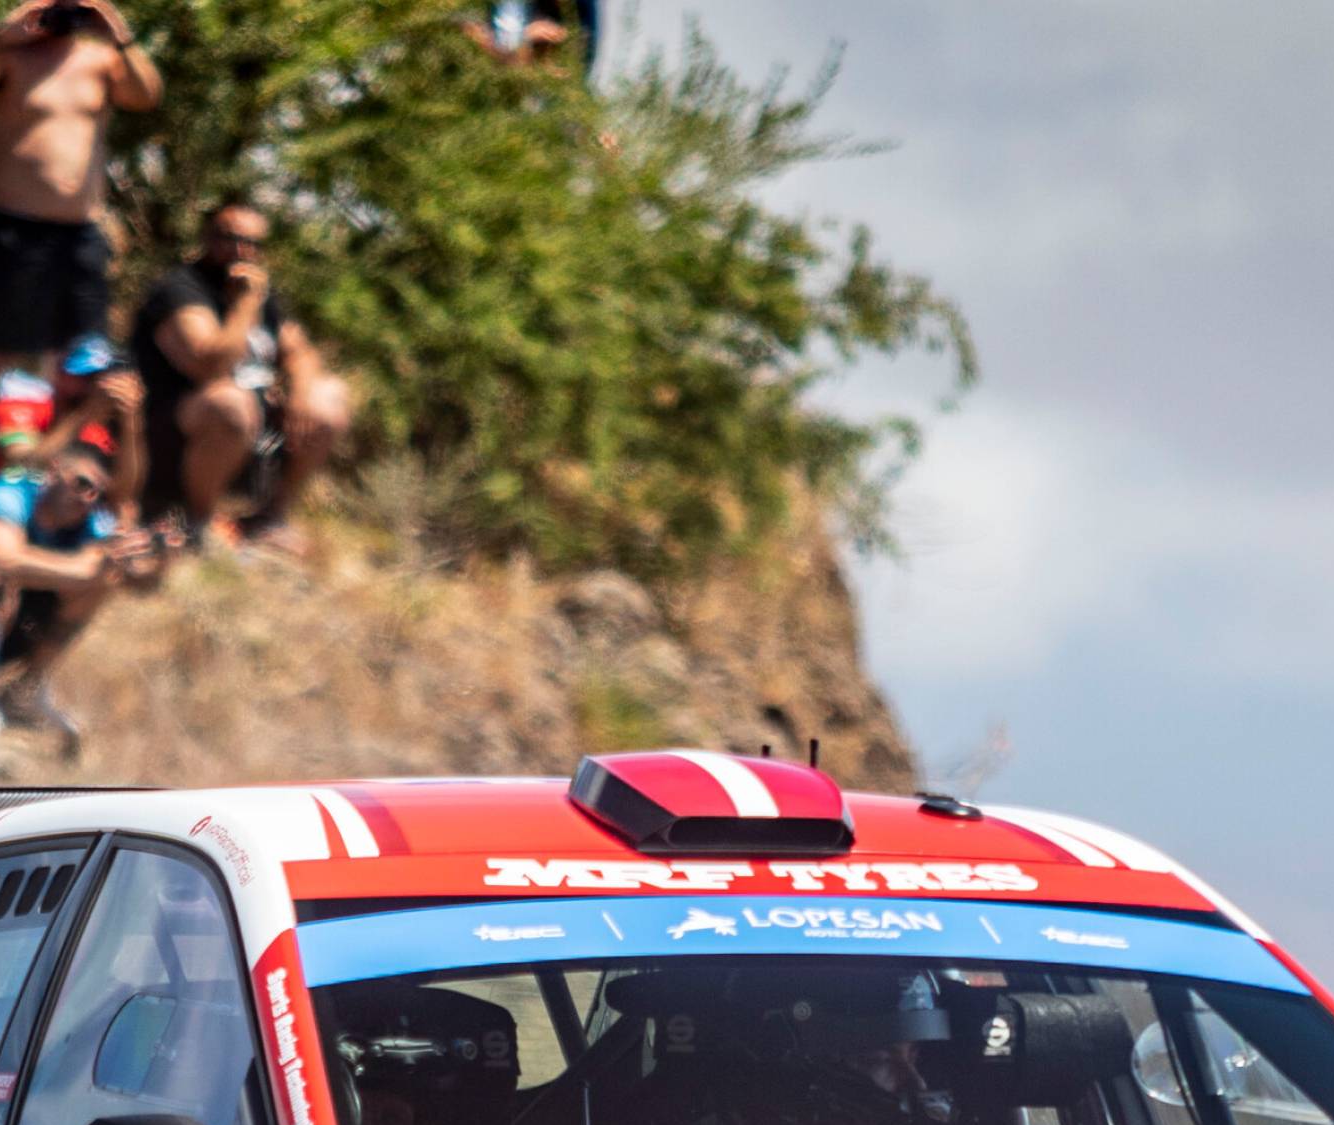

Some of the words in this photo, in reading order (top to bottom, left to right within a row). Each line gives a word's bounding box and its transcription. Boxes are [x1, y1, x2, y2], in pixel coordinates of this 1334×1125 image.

[483, 857, 754, 890] MRF
[769, 859, 1038, 891] TYRES
[742, 907, 943, 931] LOPESAN
